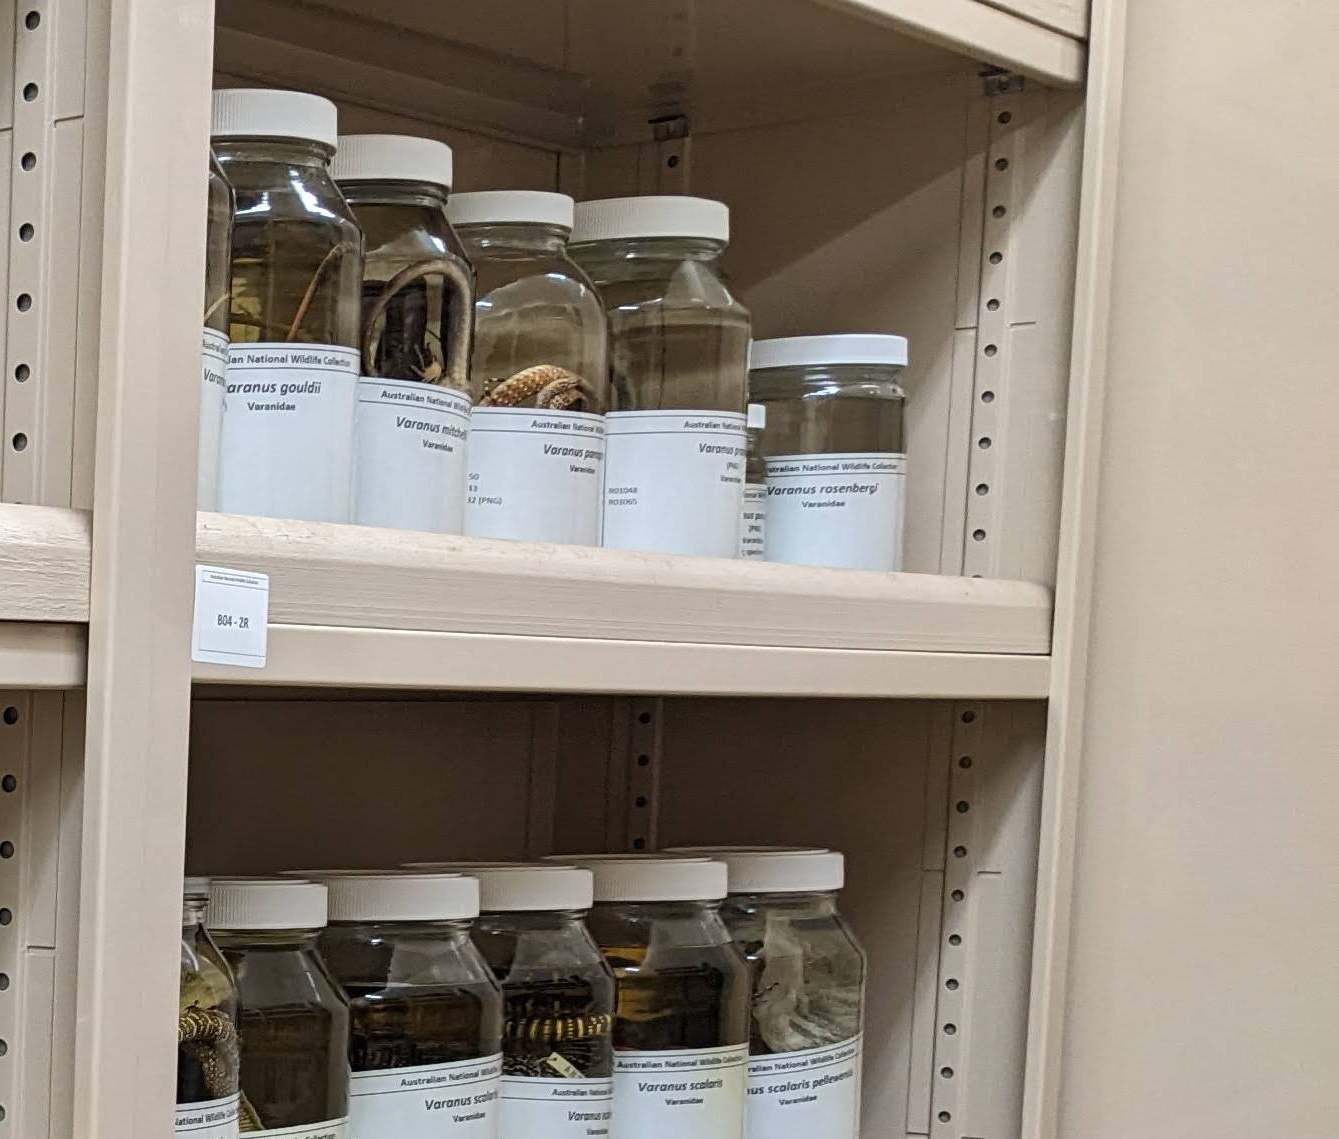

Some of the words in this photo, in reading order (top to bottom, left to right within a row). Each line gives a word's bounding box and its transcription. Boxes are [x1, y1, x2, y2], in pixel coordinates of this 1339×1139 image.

[247, 355, 287, 364] National
[227, 382, 276, 393] aranus
[280, 381, 322, 395] gouldii
[381, 390, 424, 401] Australian
[248, 402, 295, 411] Varanidae
[396, 416, 439, 433] Varanus
[531, 420, 570, 429] Australian
[544, 444, 582, 456] Varanus
[803, 464, 839, 472] National
[767, 486, 816, 495] Varanus
[820, 483, 879, 495] rosenbergi
[218, 614, 232, 626] B04
[775, 1060, 808, 1069] National
[401, 1075, 446, 1087] Australian
[449, 1070, 479, 1082] National
[638, 1082, 687, 1091] Varanus
[768, 1080, 809, 1093] scalaris
[425, 1096, 472, 1111] Varanus
